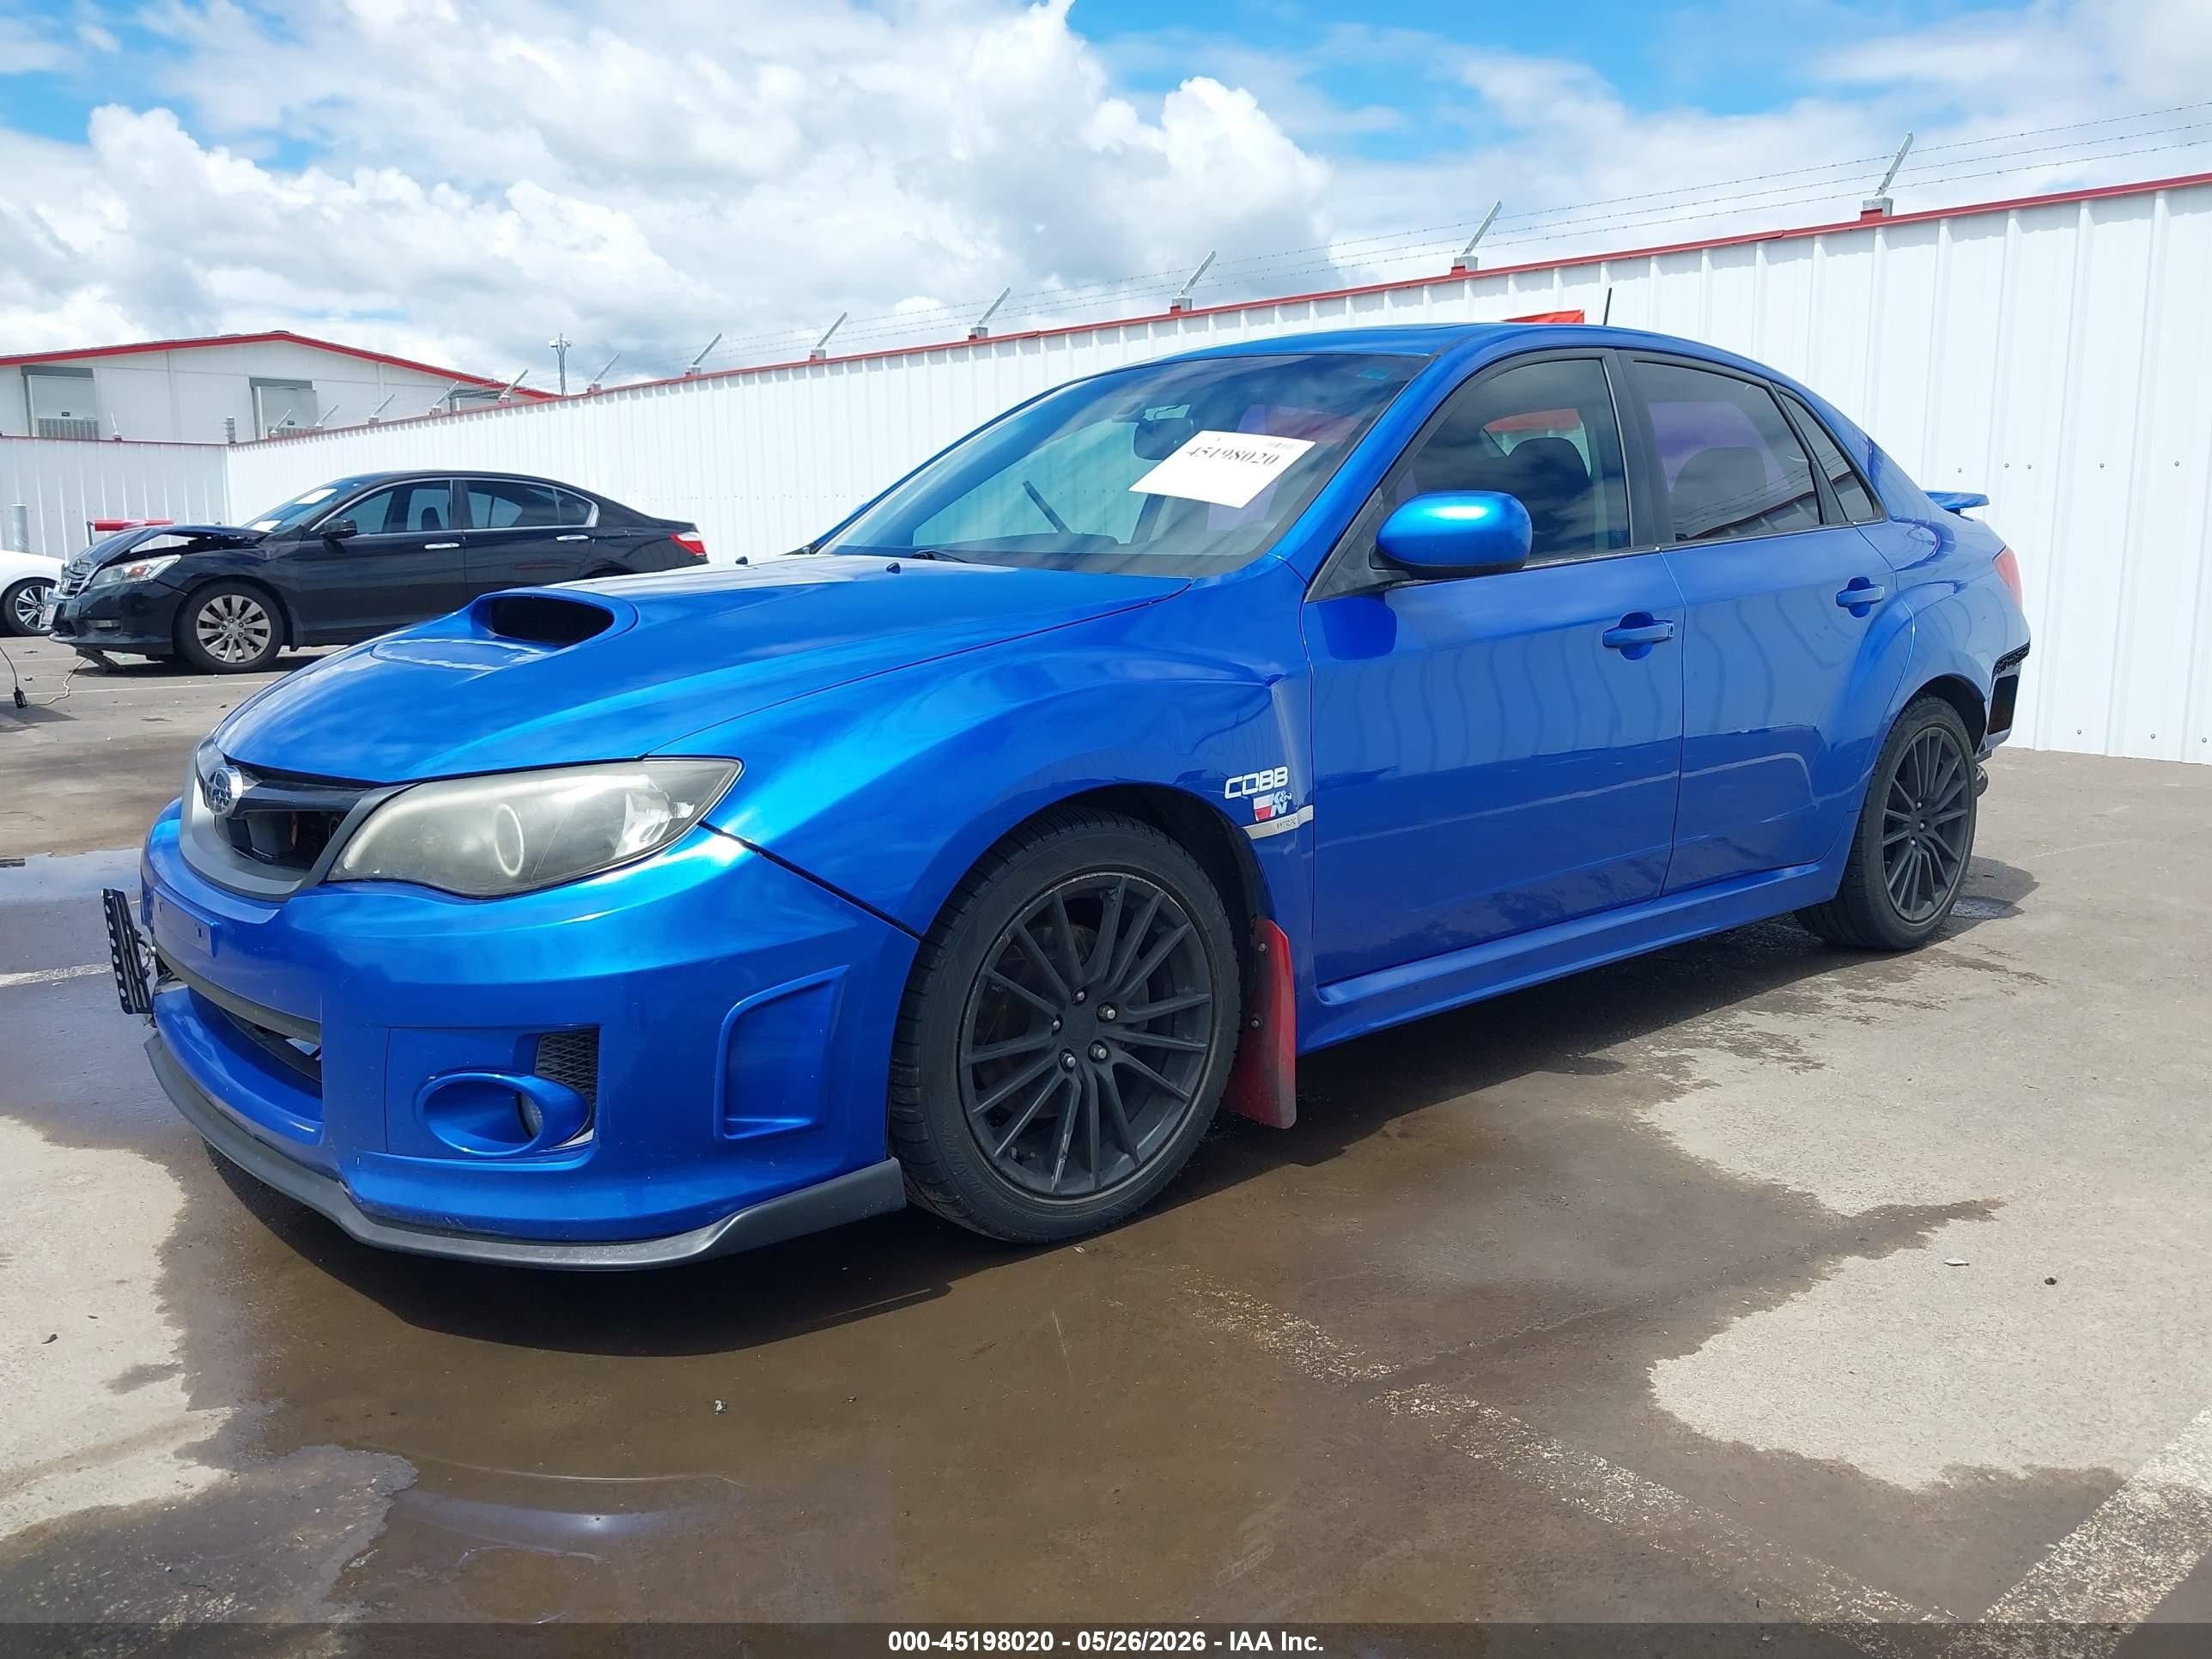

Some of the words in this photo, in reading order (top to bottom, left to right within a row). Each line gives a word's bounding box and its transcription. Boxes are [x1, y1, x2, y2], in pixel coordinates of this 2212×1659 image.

[1187, 447, 1280, 465] 45198020
[1224, 766, 1289, 799] COBB
[1276, 817, 1297, 830] WRX
